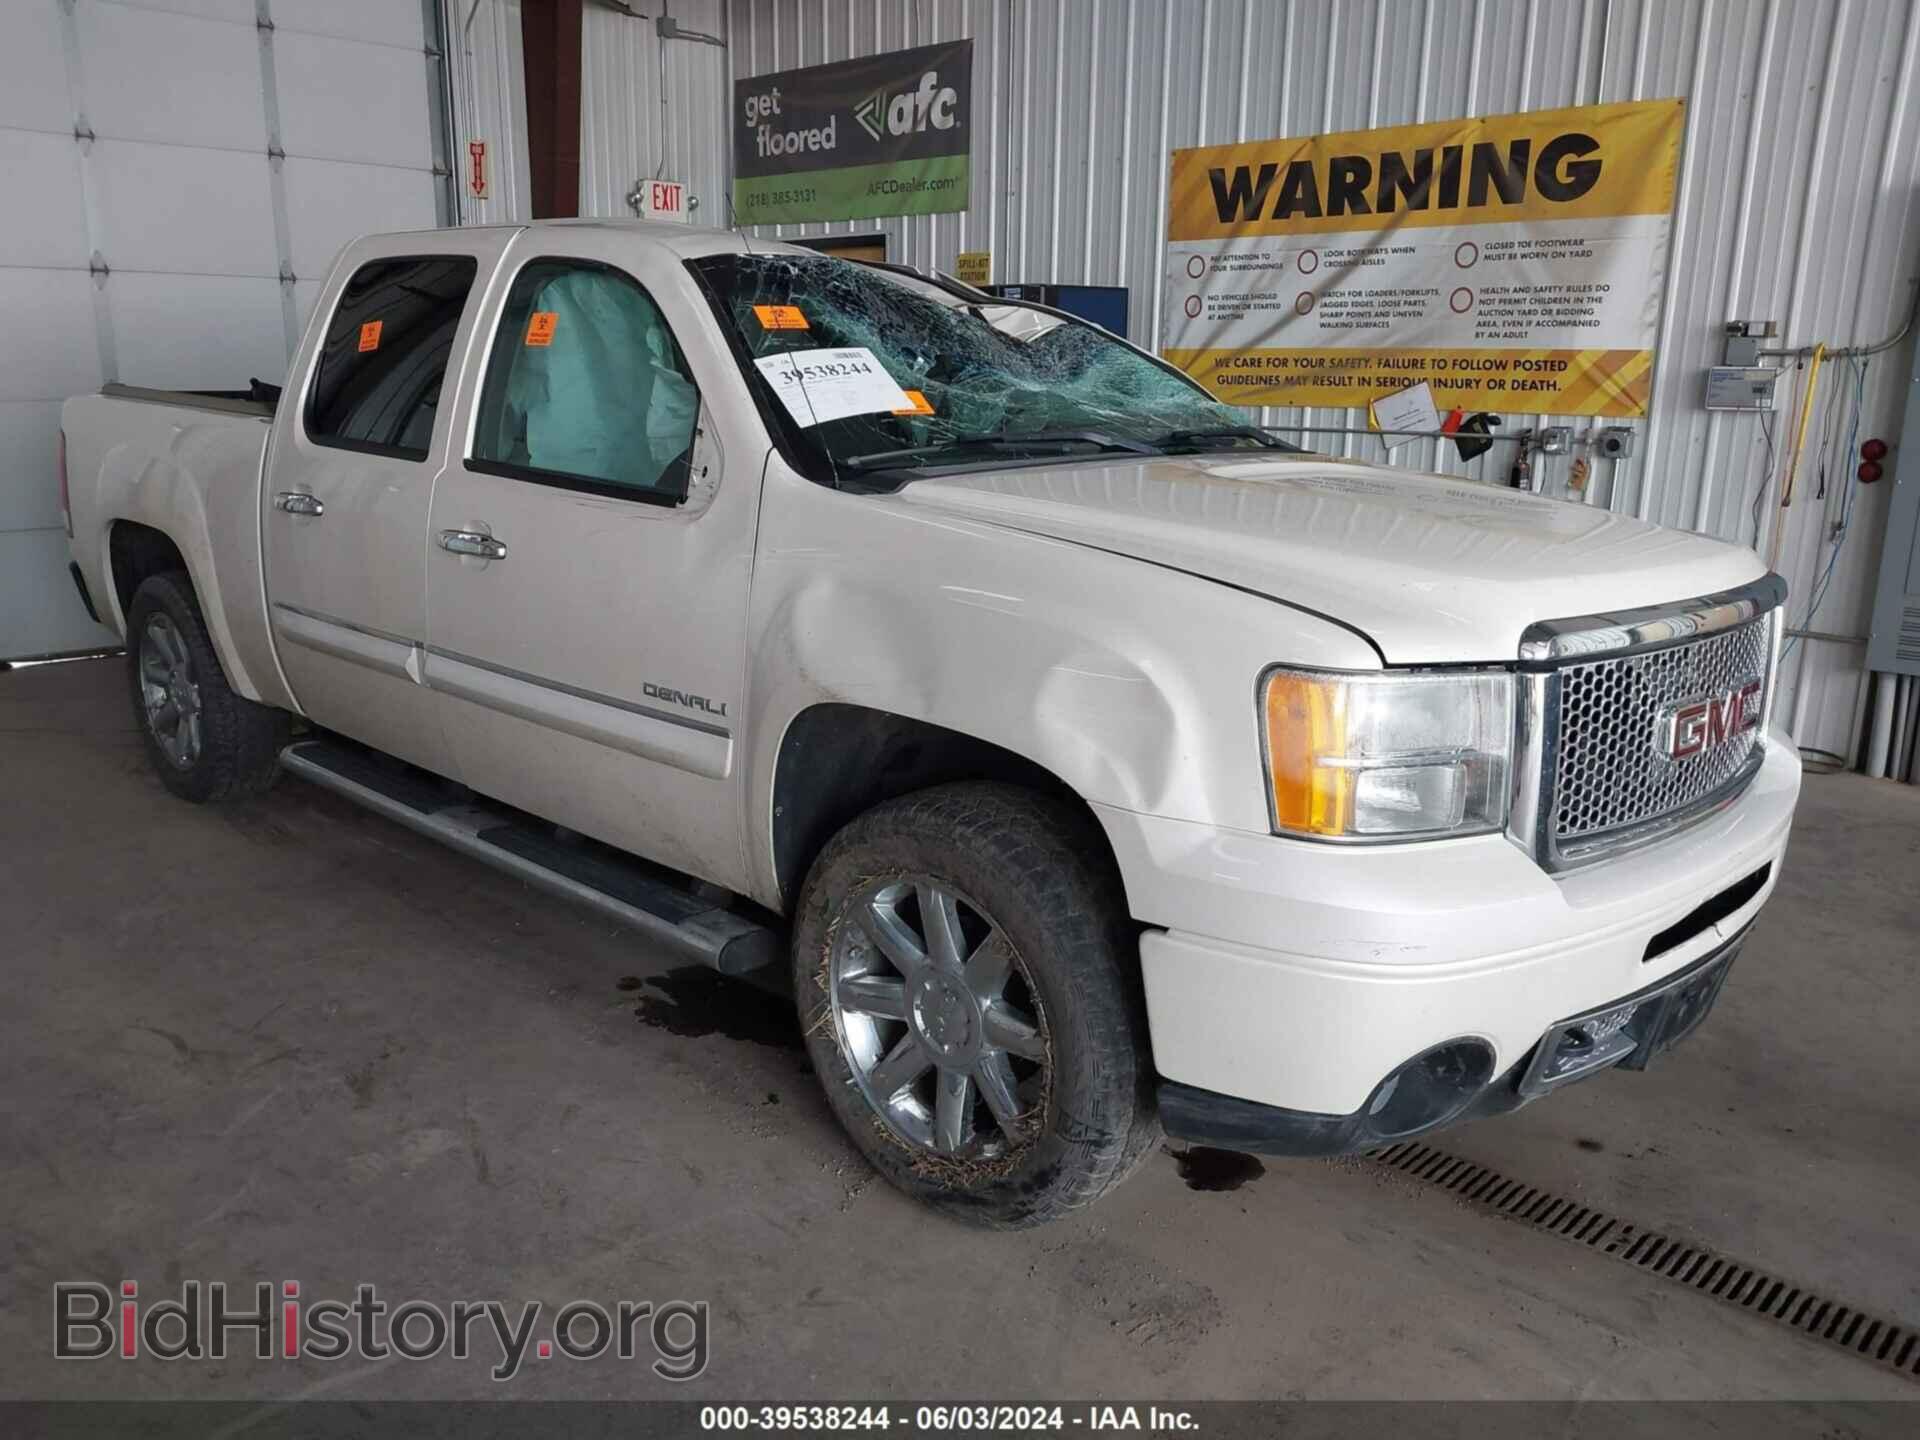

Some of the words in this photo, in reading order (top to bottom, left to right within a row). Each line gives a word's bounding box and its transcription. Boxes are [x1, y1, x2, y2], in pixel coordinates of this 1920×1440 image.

[745, 87, 781, 127] get
[887, 71, 957, 137] afc
[757, 115, 837, 158] floored
[1208, 132, 1603, 223] WARNING
[652, 183, 682, 212] EXIT
[1485, 240, 1515, 250] CLOSED
[1517, 240, 1532, 249] TOE
[1534, 238, 1585, 248] FOOTWEAR
[1323, 249, 1345, 258] LOOK
[1391, 246, 1416, 255] WHEN
[1483, 253, 1506, 262] MUST
[1508, 252, 1518, 261] BE
[1520, 251, 1549, 260] WORN
[1551, 251, 1566, 259] ON
[1569, 249, 1593, 258] YARD
[1223, 254, 1260, 262] ATTENTION
[1362, 258, 1386, 266] AISLES
[1230, 262, 1284, 271] SURROUNDINGS
[1348, 289, 1362, 298] FOR
[1479, 286, 1510, 295] HEALTH
[1512, 286, 1531, 294] AND
[1533, 284, 1564, 294] SAFETY
[1566, 284, 1593, 293] RULES
[1595, 284, 1610, 292] DO
[1250, 292, 1278, 300] SHOULD
[1478, 298, 1497, 307] NOT
[1498, 297, 1527, 306] PERMIT
[1529, 297, 1571, 305] CHILDREN
[1573, 296, 1584, 304] IN
[1586, 296, 1603, 304] THE
[1253, 302, 1281, 310] STARTED
[1320, 300, 1349, 308] JAGGED
[1377, 299, 1401, 307] LOOSE
[1320, 310, 1344, 319] SHARP
[1346, 310, 1372, 318] POINTS
[1374, 310, 1390, 318] AND
[1392, 310, 1423, 318] UNEVEN
[1477, 308, 1514, 317] AUCTION
[1517, 308, 1539, 317] YARD
[1541, 308, 1553, 317] OR
[1555, 308, 1595, 316] BIDDING
[1320, 321, 1354, 329] WALKING
[1355, 320, 1390, 329] SURFACES
[1502, 319, 1524, 328] EVEN
[1525, 319, 1534, 328] IF
[1535, 319, 1601, 328] ACCOMPANIED
[1475, 331, 1485, 339] BY
[1487, 331, 1500, 339] AN
[1502, 330, 1529, 339] ADULT
[1215, 357, 1230, 368] WE
[1234, 357, 1262, 368] CARE
[1266, 357, 1289, 368] FOR
[1293, 357, 1325, 369] YOUR
[1329, 357, 1373, 369] SAFETY.
[1377, 358, 1426, 370] FAILURE
[1431, 358, 1448, 370] TO
[1452, 359, 1508, 371] FOLLOW
[1513, 359, 1568, 372] POSTED
[779, 361, 872, 385] 39538244
[1217, 374, 1281, 385] GUIDELINES
[1284, 375, 1307, 386] MAY
[1312, 375, 1353, 387] RESULT
[1358, 376, 1372, 387] IN
[1433, 377, 1482, 390] INJURY
[1487, 378, 1506, 391] OR
[1511, 379, 1562, 392] DEATH.
[643, 682, 727, 717] DENALI
[1668, 680, 1761, 761] GMC
